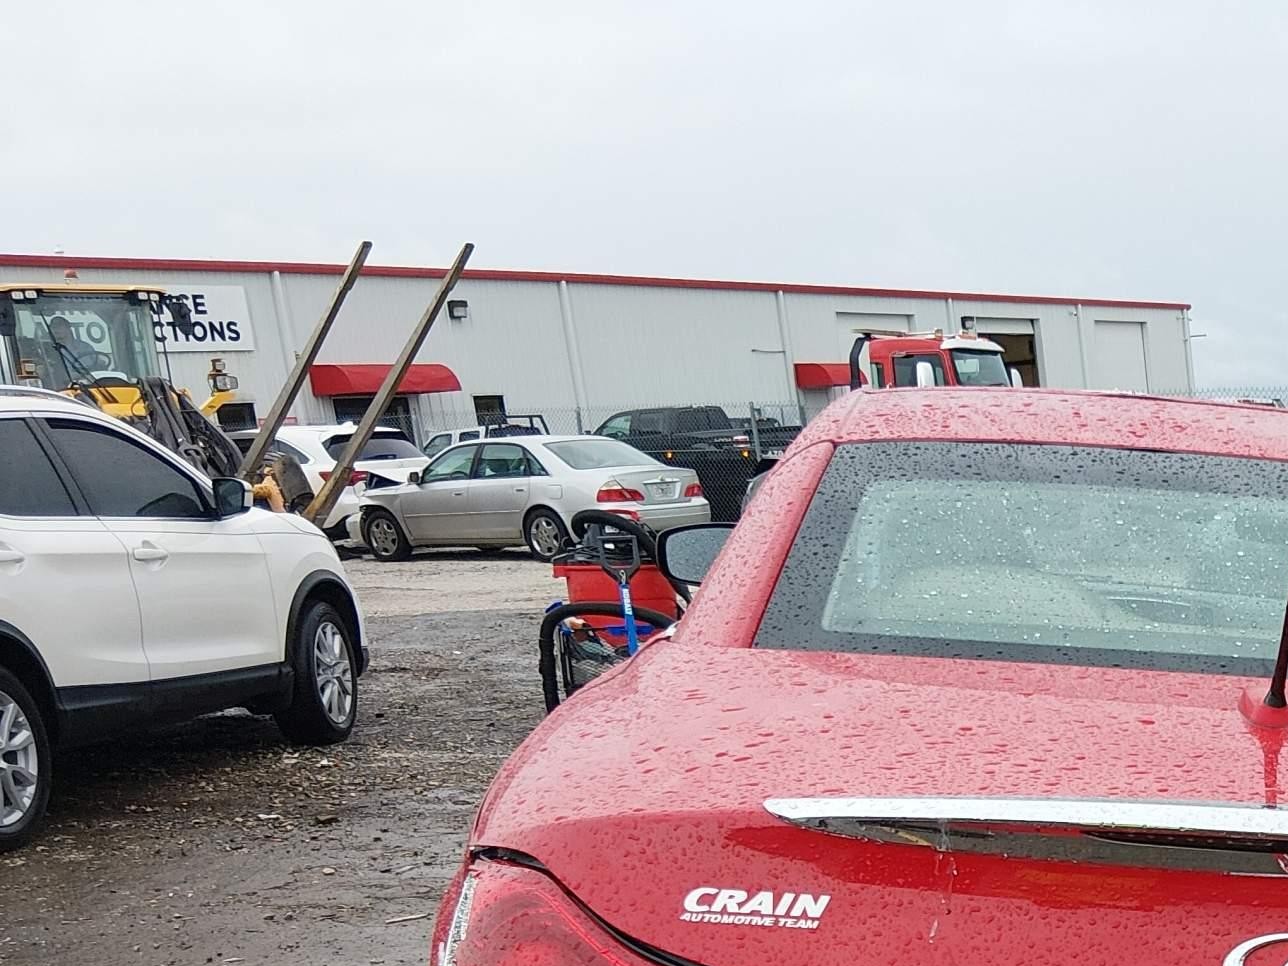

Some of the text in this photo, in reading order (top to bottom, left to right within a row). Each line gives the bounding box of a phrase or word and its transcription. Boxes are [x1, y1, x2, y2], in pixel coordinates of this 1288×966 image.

[34, 321, 107, 344] ATO
[683, 886, 832, 919] CRAIN
[679, 911, 820, 930] AUTOMOTIVE TEAM
